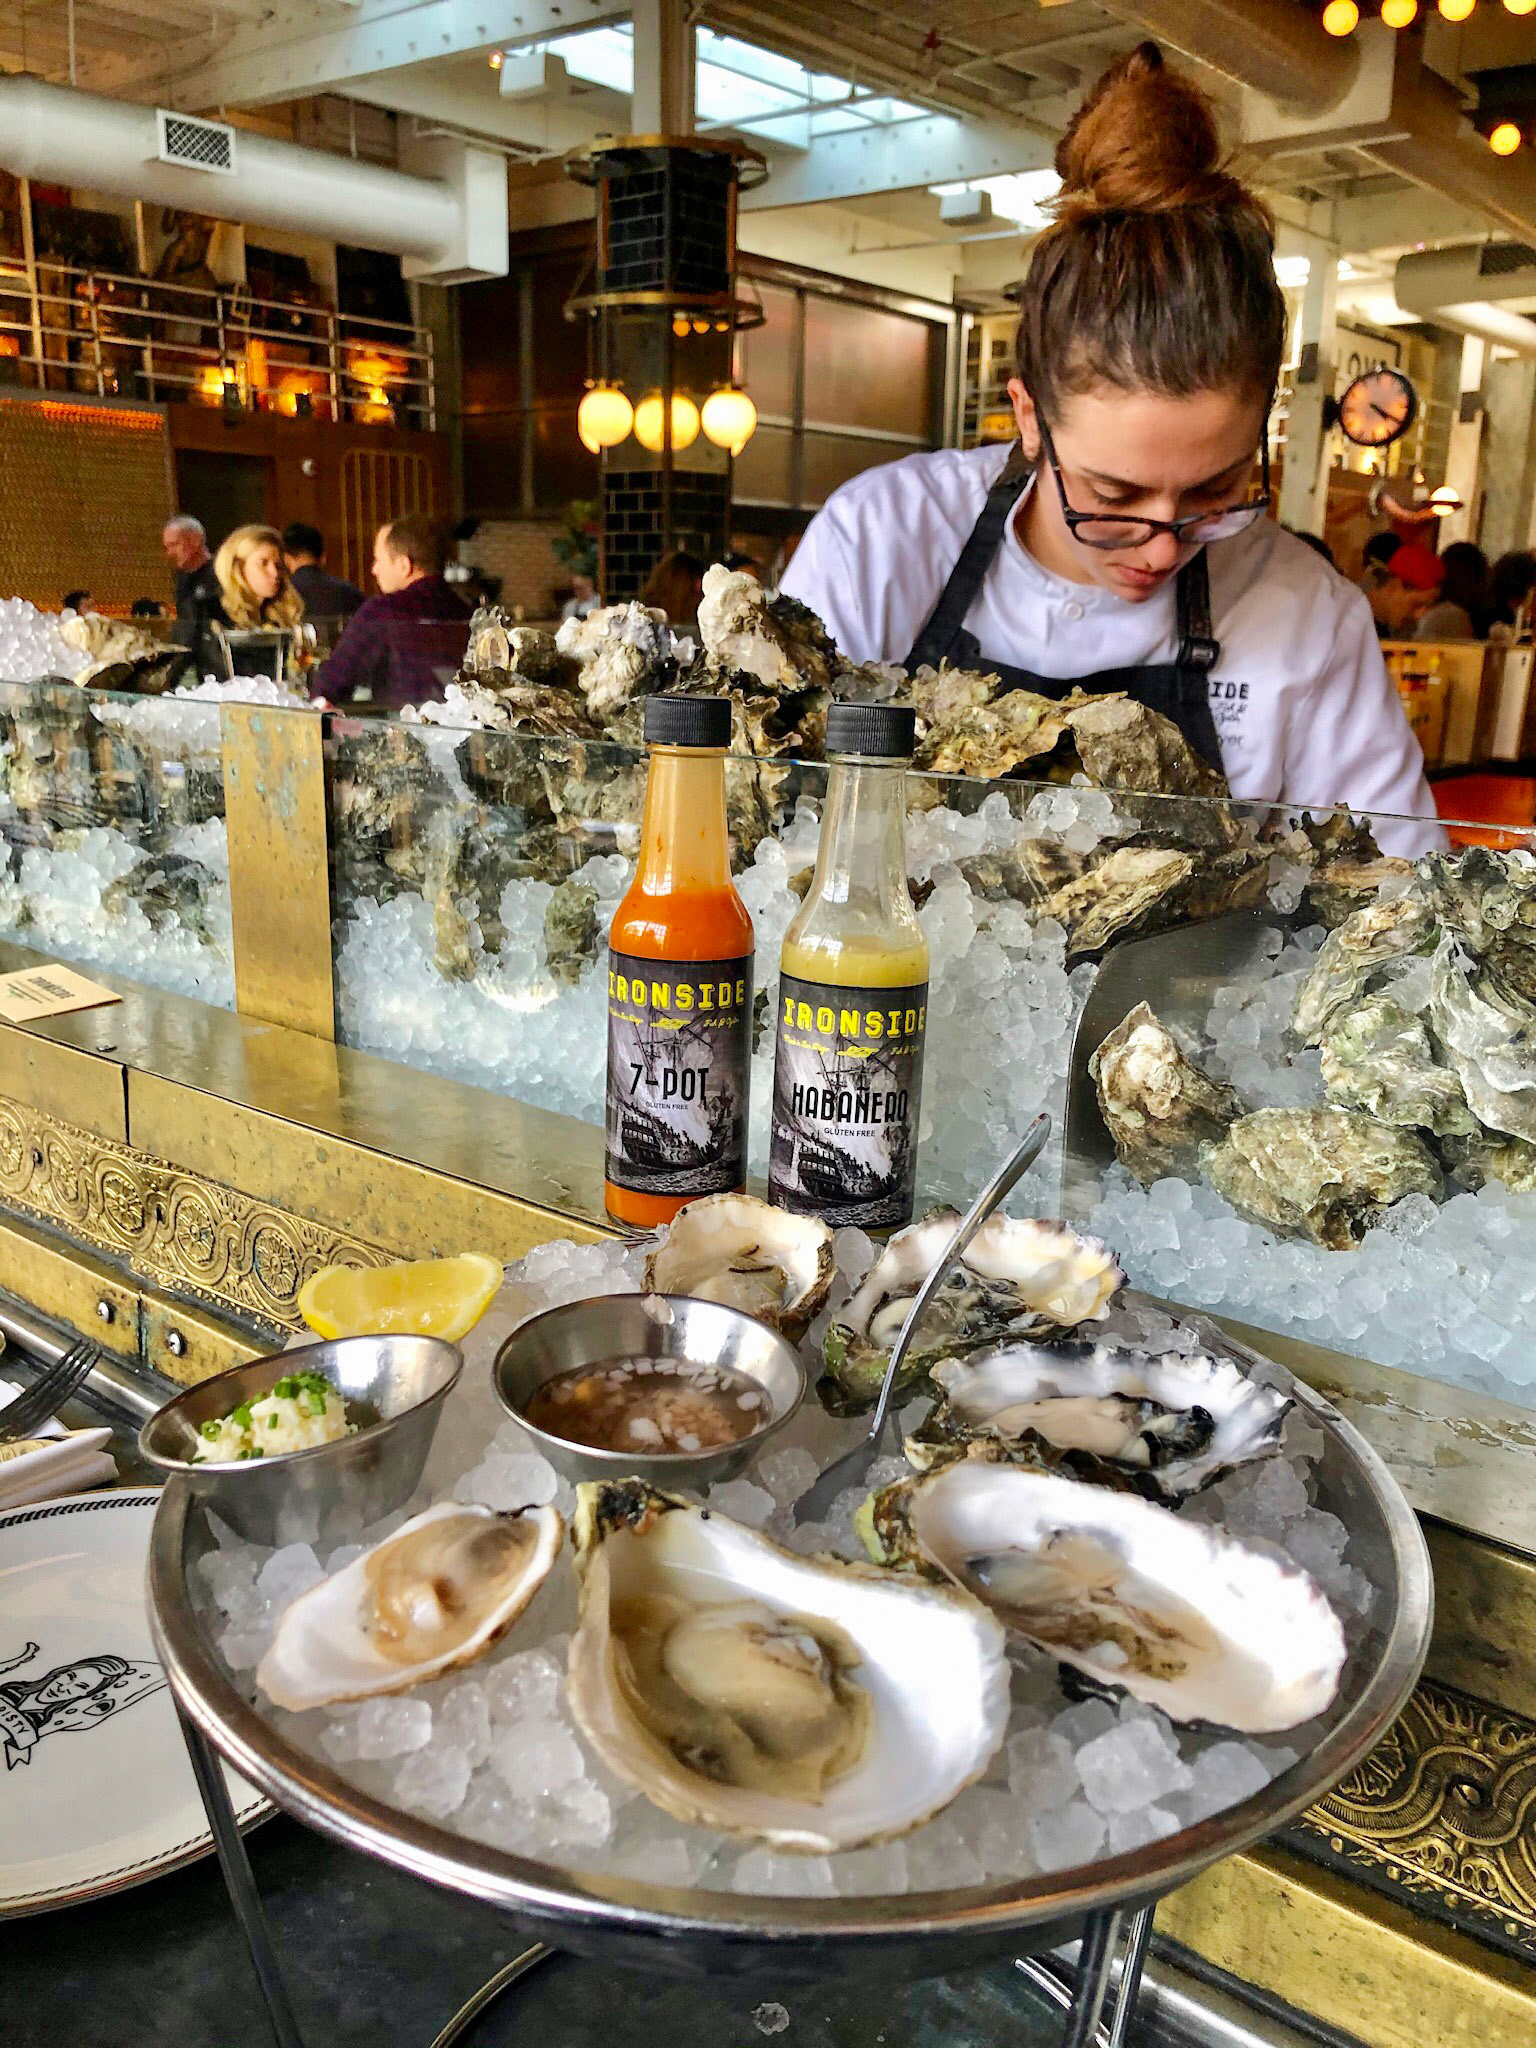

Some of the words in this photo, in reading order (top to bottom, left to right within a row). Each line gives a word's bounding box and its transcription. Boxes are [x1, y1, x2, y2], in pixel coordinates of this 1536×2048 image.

[1207, 681, 1249, 699] IDE
[608, 970, 746, 1011] IRONSIDE
[783, 997, 926, 1039] IRONSIDE
[629, 1062, 710, 1102] 7-POT
[645, 1101, 671, 1110] GLUTEN
[823, 1127, 855, 1137] GLUTEN
[856, 1129, 876, 1138] FREE
